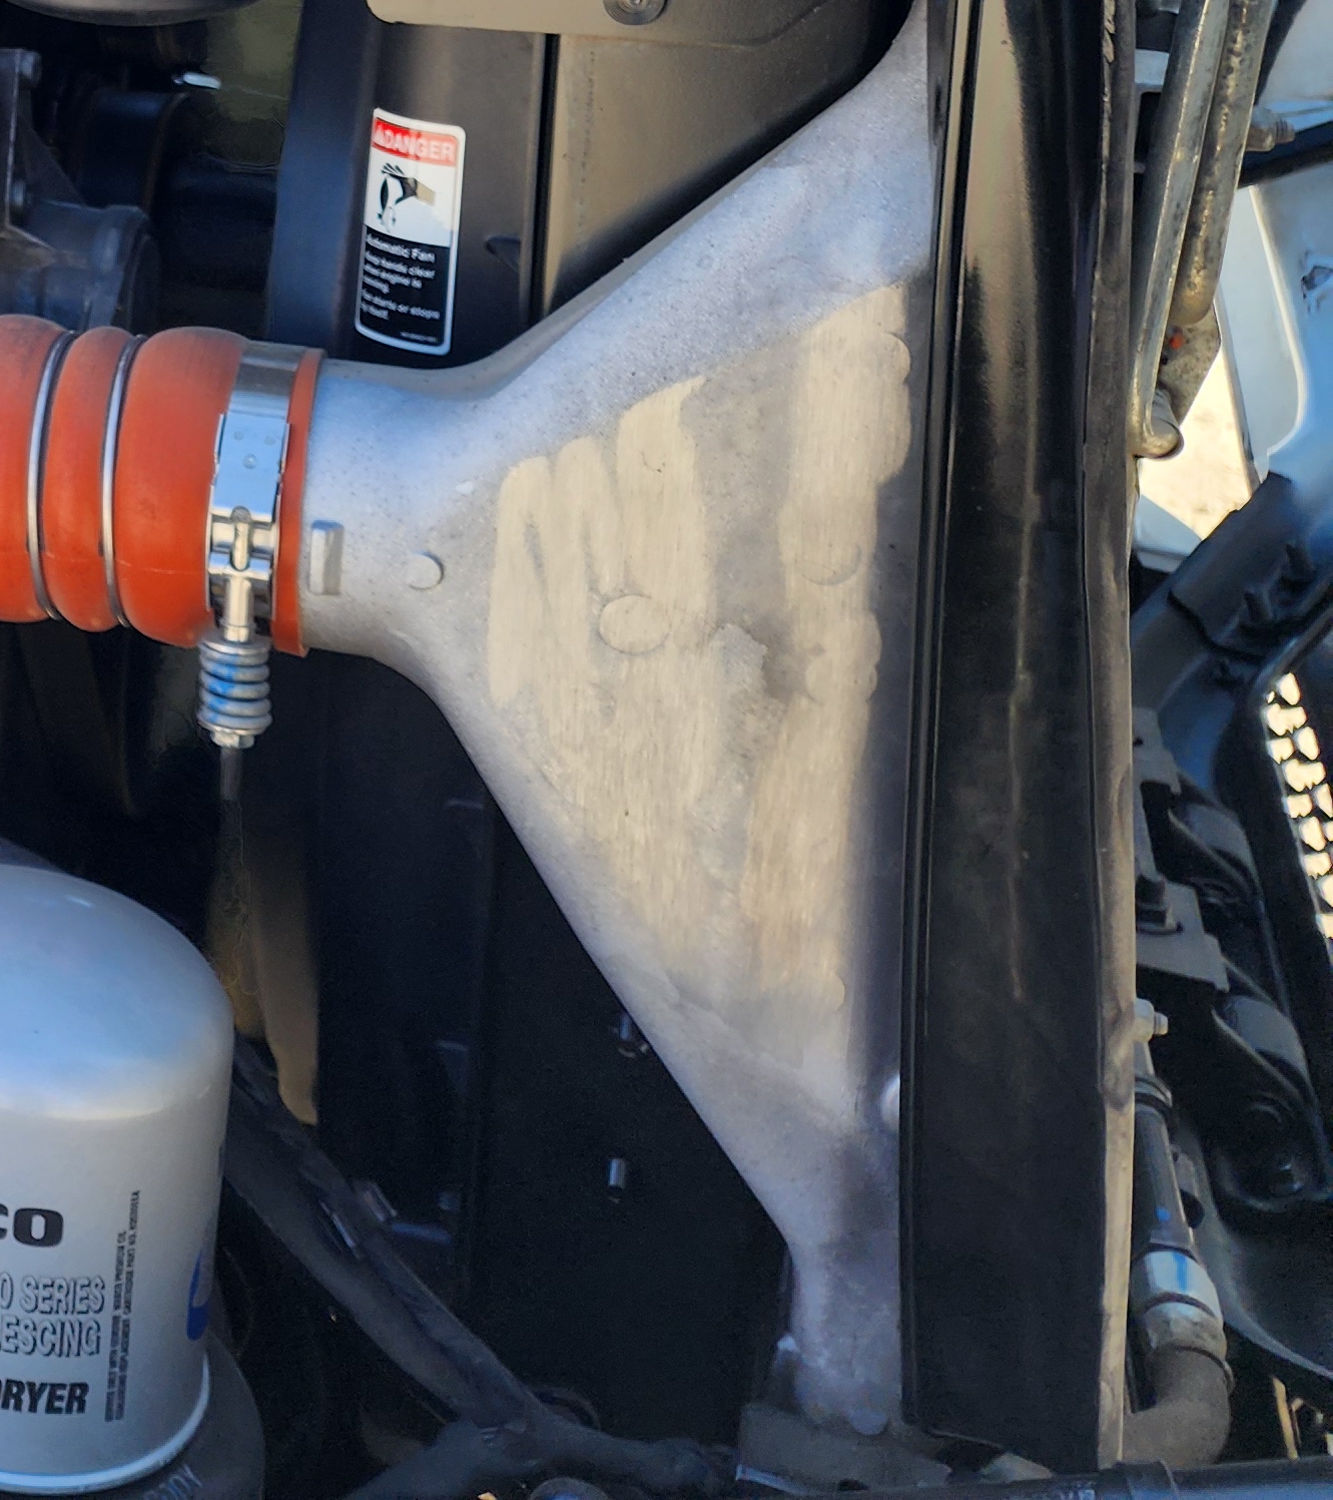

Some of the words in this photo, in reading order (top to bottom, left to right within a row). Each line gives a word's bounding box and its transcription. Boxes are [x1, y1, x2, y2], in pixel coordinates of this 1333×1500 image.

[385, 130, 455, 161] DANGER
[411, 247, 436, 264] Fan
[409, 264, 436, 280] clear
[20, 1274, 107, 1316] SERIES
